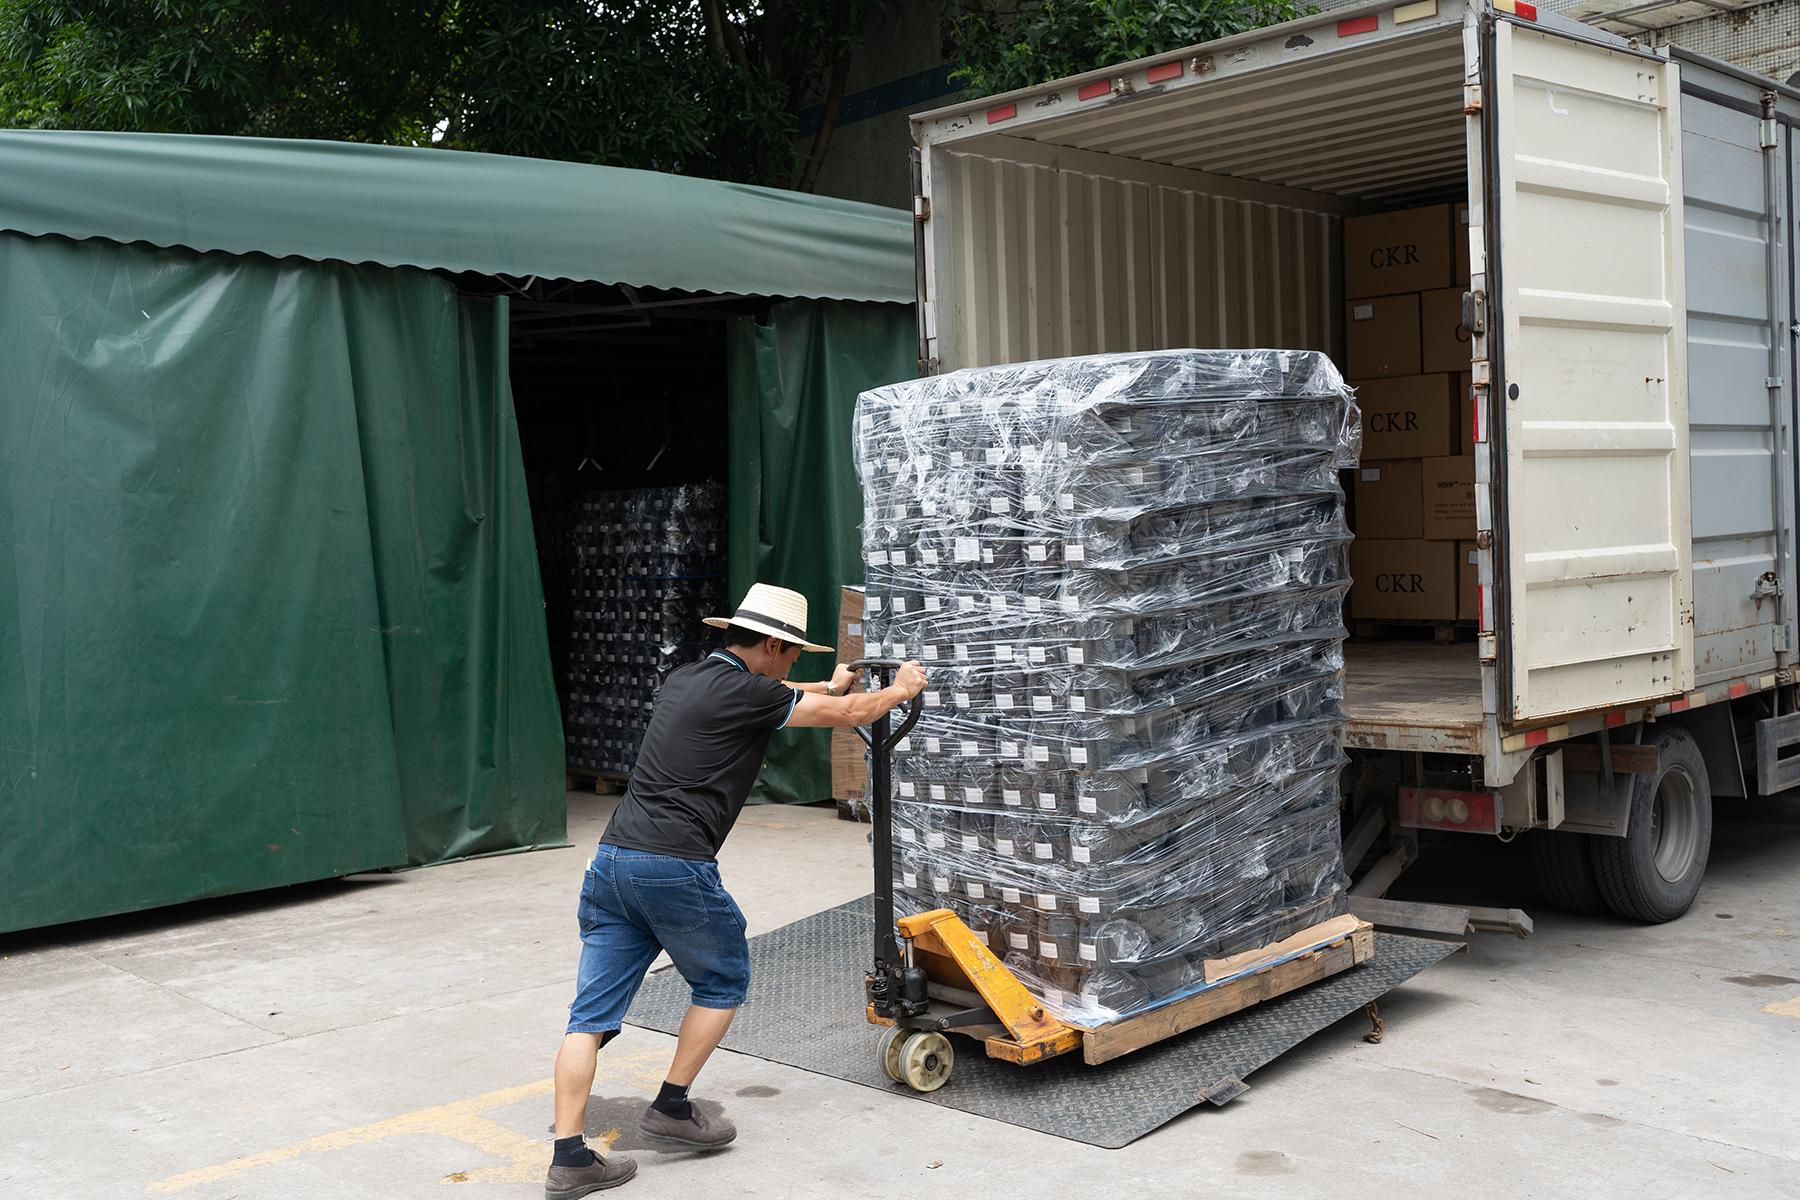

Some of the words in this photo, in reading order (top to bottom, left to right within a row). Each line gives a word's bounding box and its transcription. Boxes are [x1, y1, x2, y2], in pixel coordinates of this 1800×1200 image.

[1370, 244, 1420, 269] CKR
[1370, 411, 1420, 433] CKR
[1375, 573, 1426, 593] CKR
